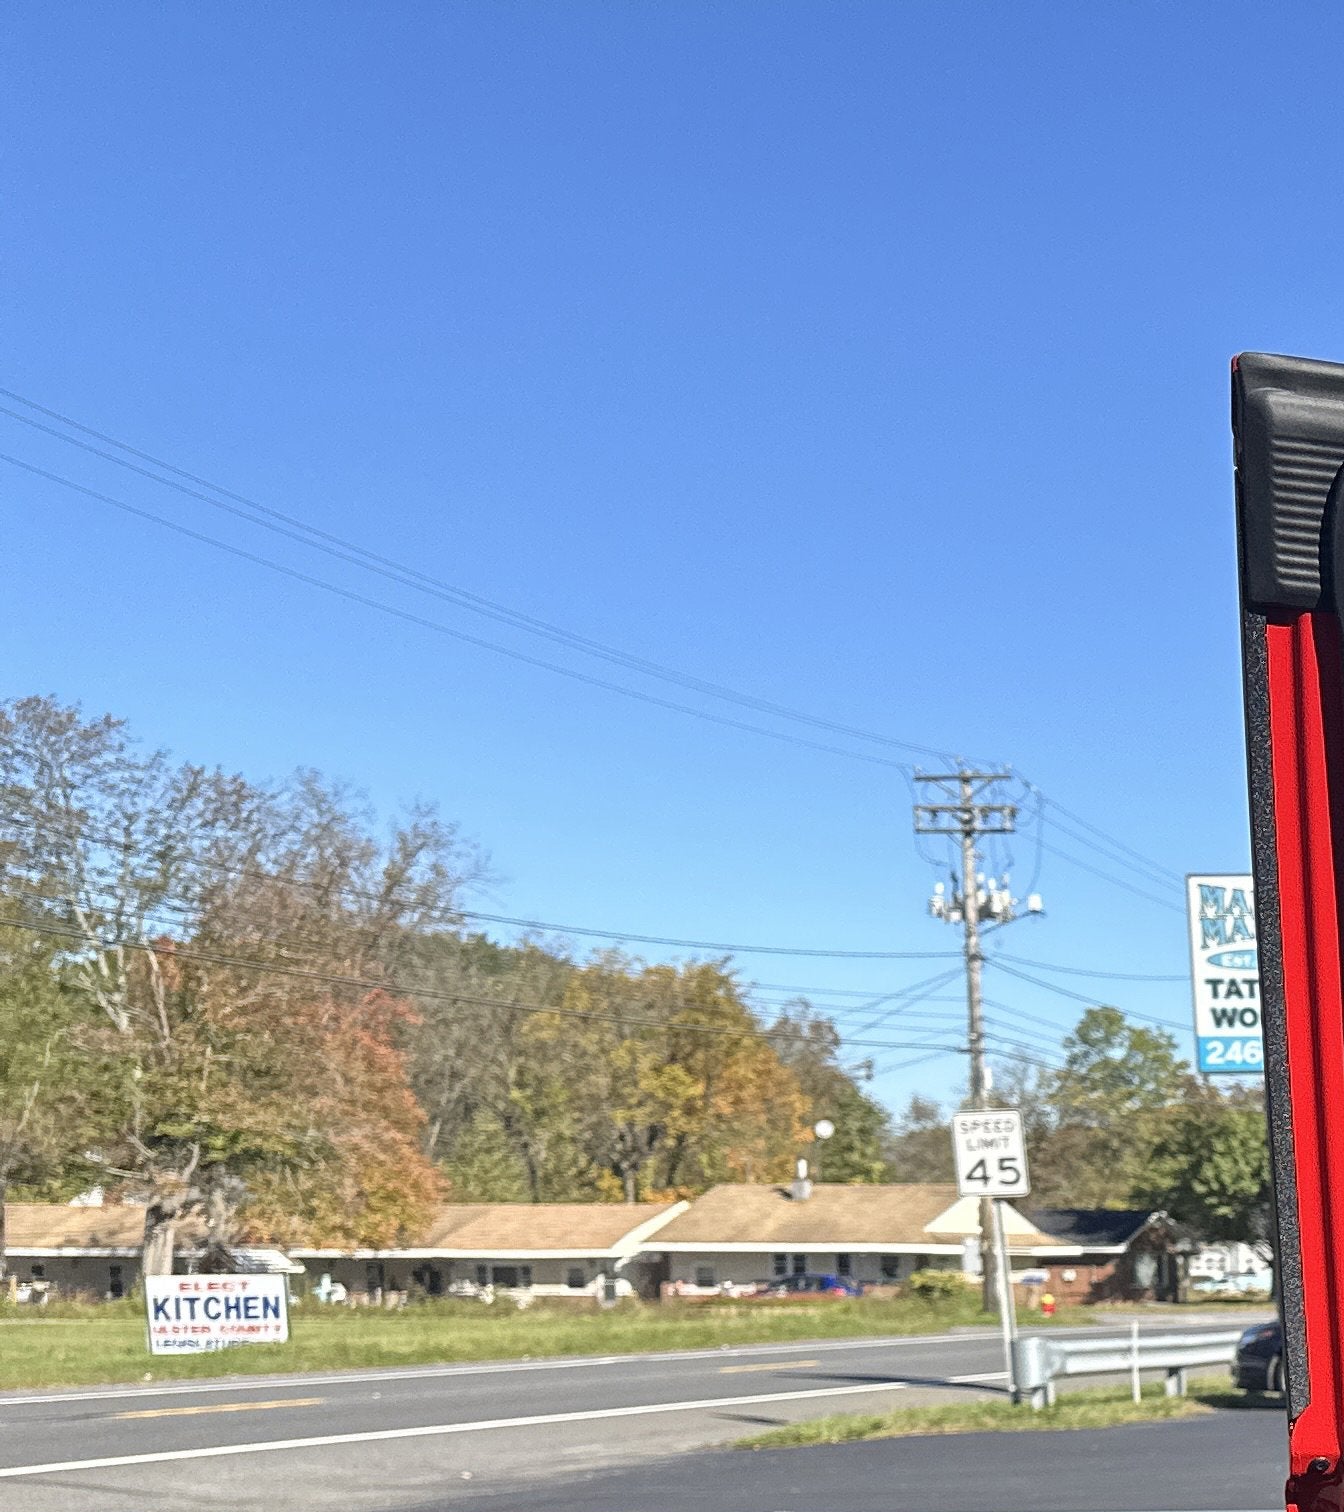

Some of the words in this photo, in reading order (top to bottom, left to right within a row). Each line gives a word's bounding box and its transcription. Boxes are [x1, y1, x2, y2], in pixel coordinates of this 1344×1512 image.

[1198, 884, 1254, 919] MA
[1200, 917, 1255, 950] MA
[1204, 978, 1259, 1000] TAT
[1211, 1007, 1260, 1028] WO
[1206, 1040, 1262, 1066] 246
[960, 1119, 1014, 1134] SPEED
[966, 1136, 1009, 1151] LIMIT
[966, 1157, 1021, 1187] 45
[179, 1281, 249, 1292] ELECT
[152, 1296, 281, 1321] KITCHEN
